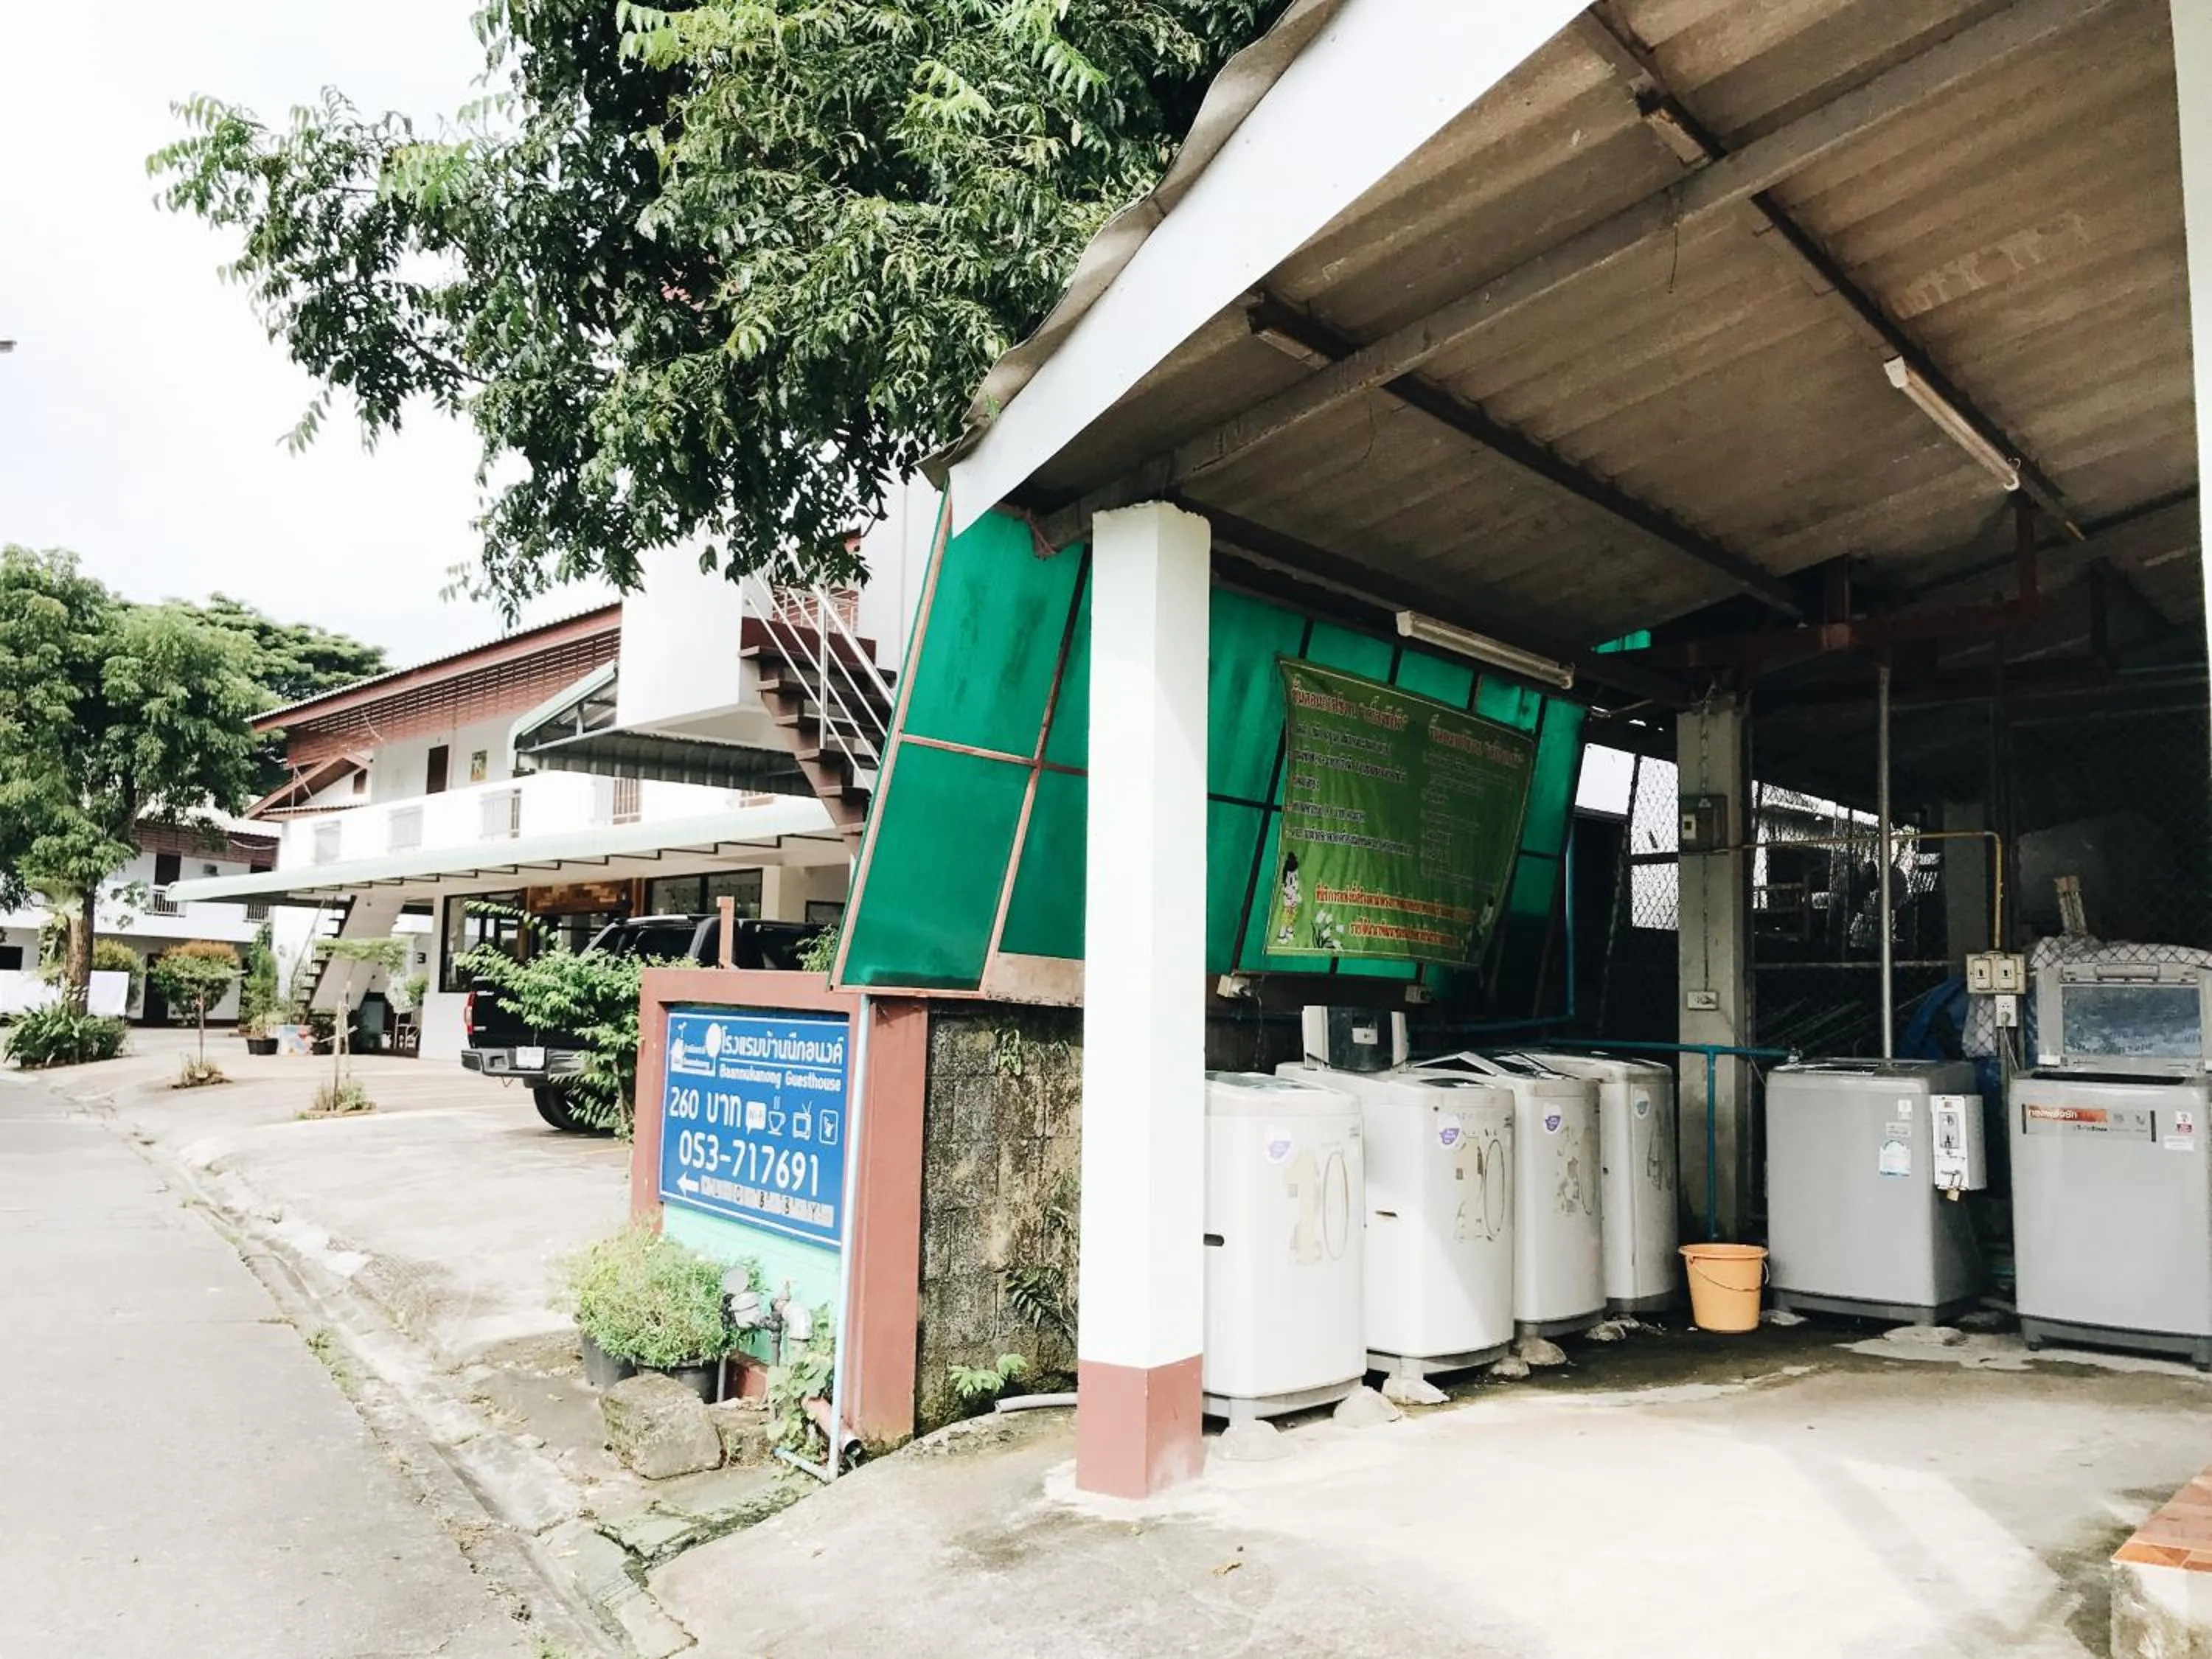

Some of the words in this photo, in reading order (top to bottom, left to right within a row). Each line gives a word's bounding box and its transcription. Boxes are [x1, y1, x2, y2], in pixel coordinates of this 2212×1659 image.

[785, 1071, 841, 1091] Guesthouse
[669, 1087, 700, 1120] 260
[706, 1092, 742, 1128] บาท
[679, 1129, 819, 1197] 053-717691
